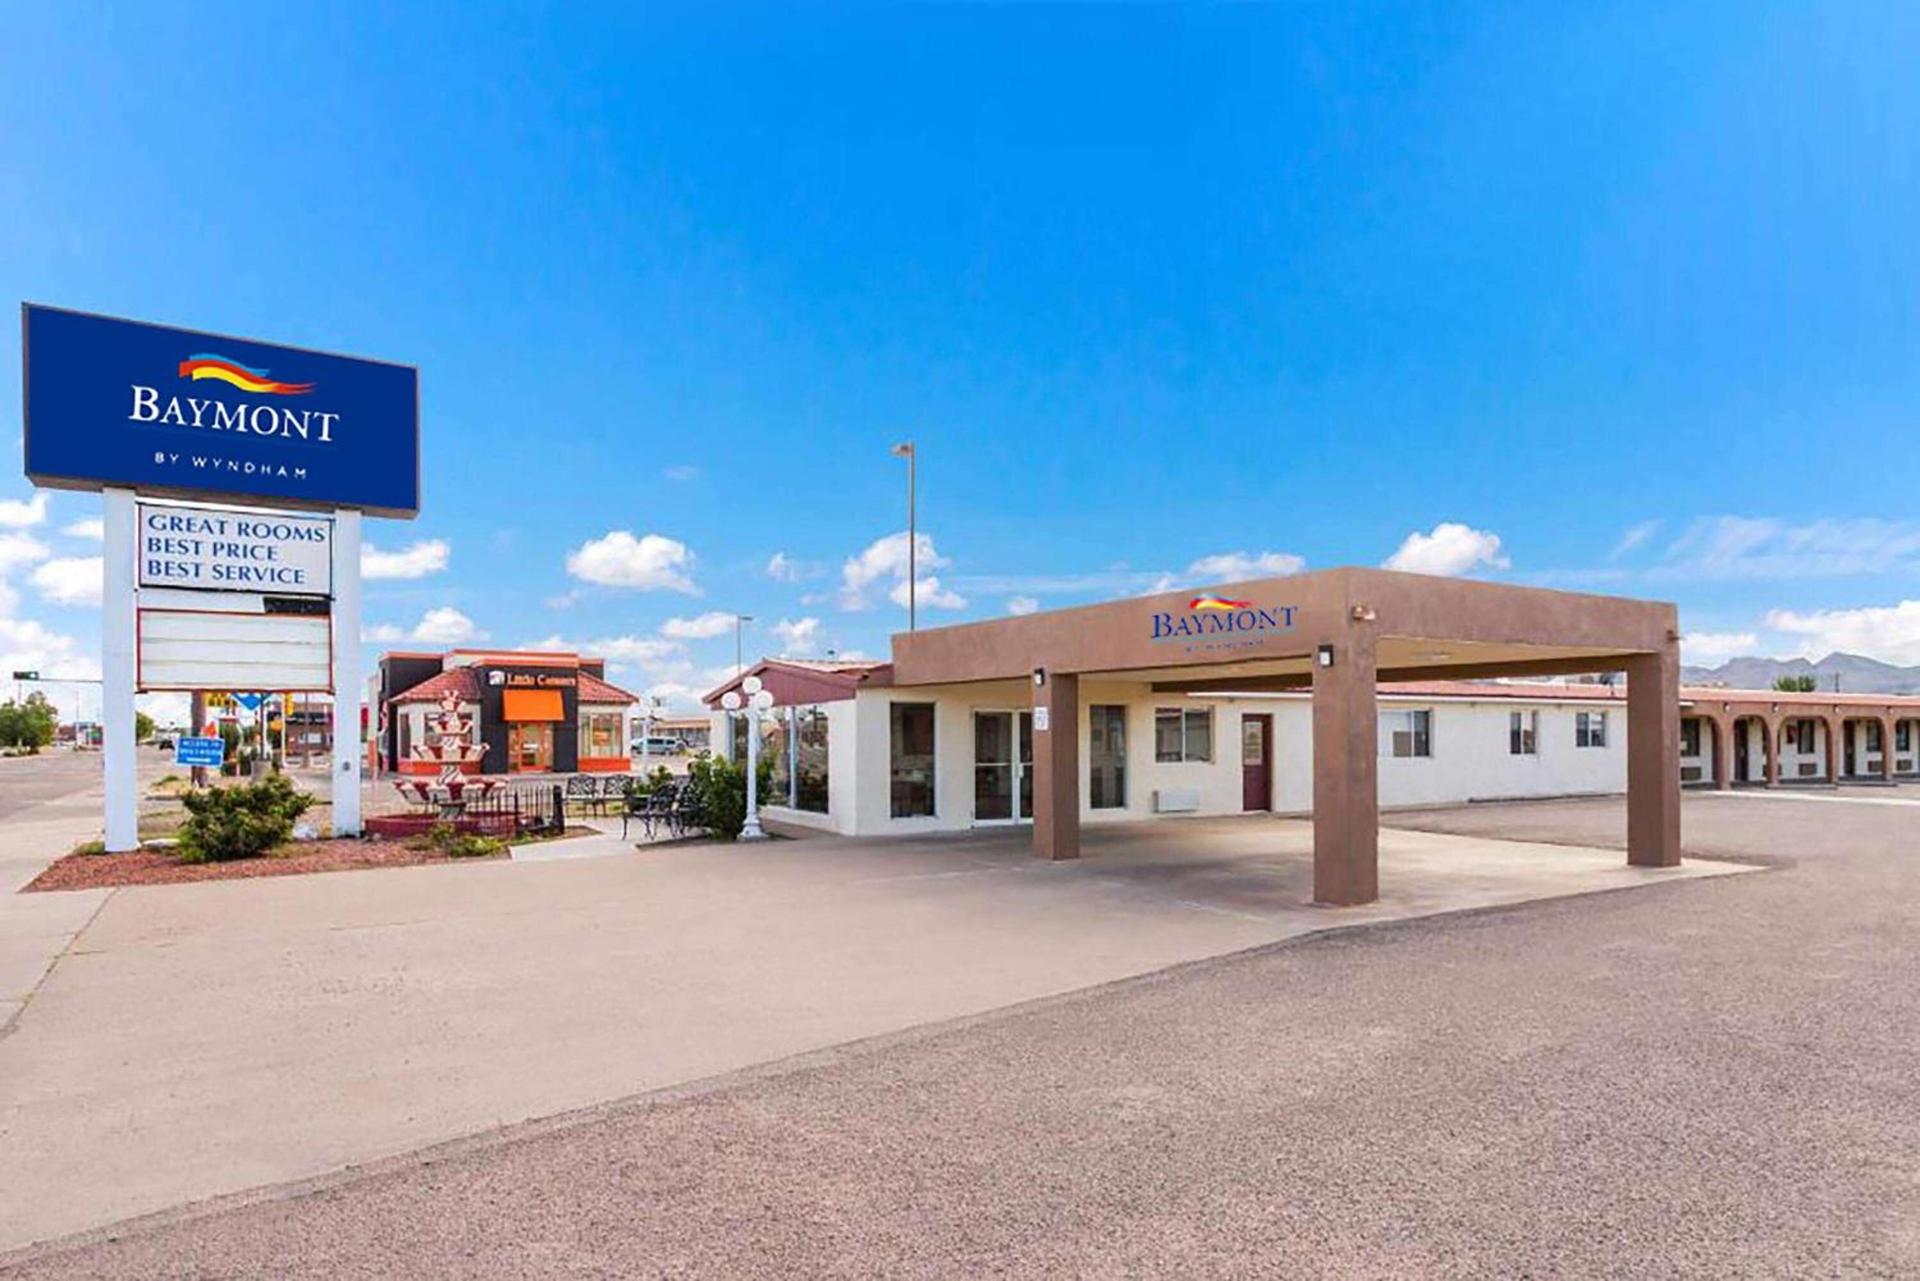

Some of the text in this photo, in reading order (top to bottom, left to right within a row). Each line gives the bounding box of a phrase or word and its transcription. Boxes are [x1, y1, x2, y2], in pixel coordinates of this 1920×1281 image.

[128, 384, 340, 442] BAYMONT
[154, 451, 307, 480] BY WYNDHAM
[147, 513, 326, 543] GREAT ROOMS
[147, 537, 279, 562] BEST PRICE
[147, 559, 306, 585] BEST SERVICE
[1151, 605, 1299, 639] BAYMONT
